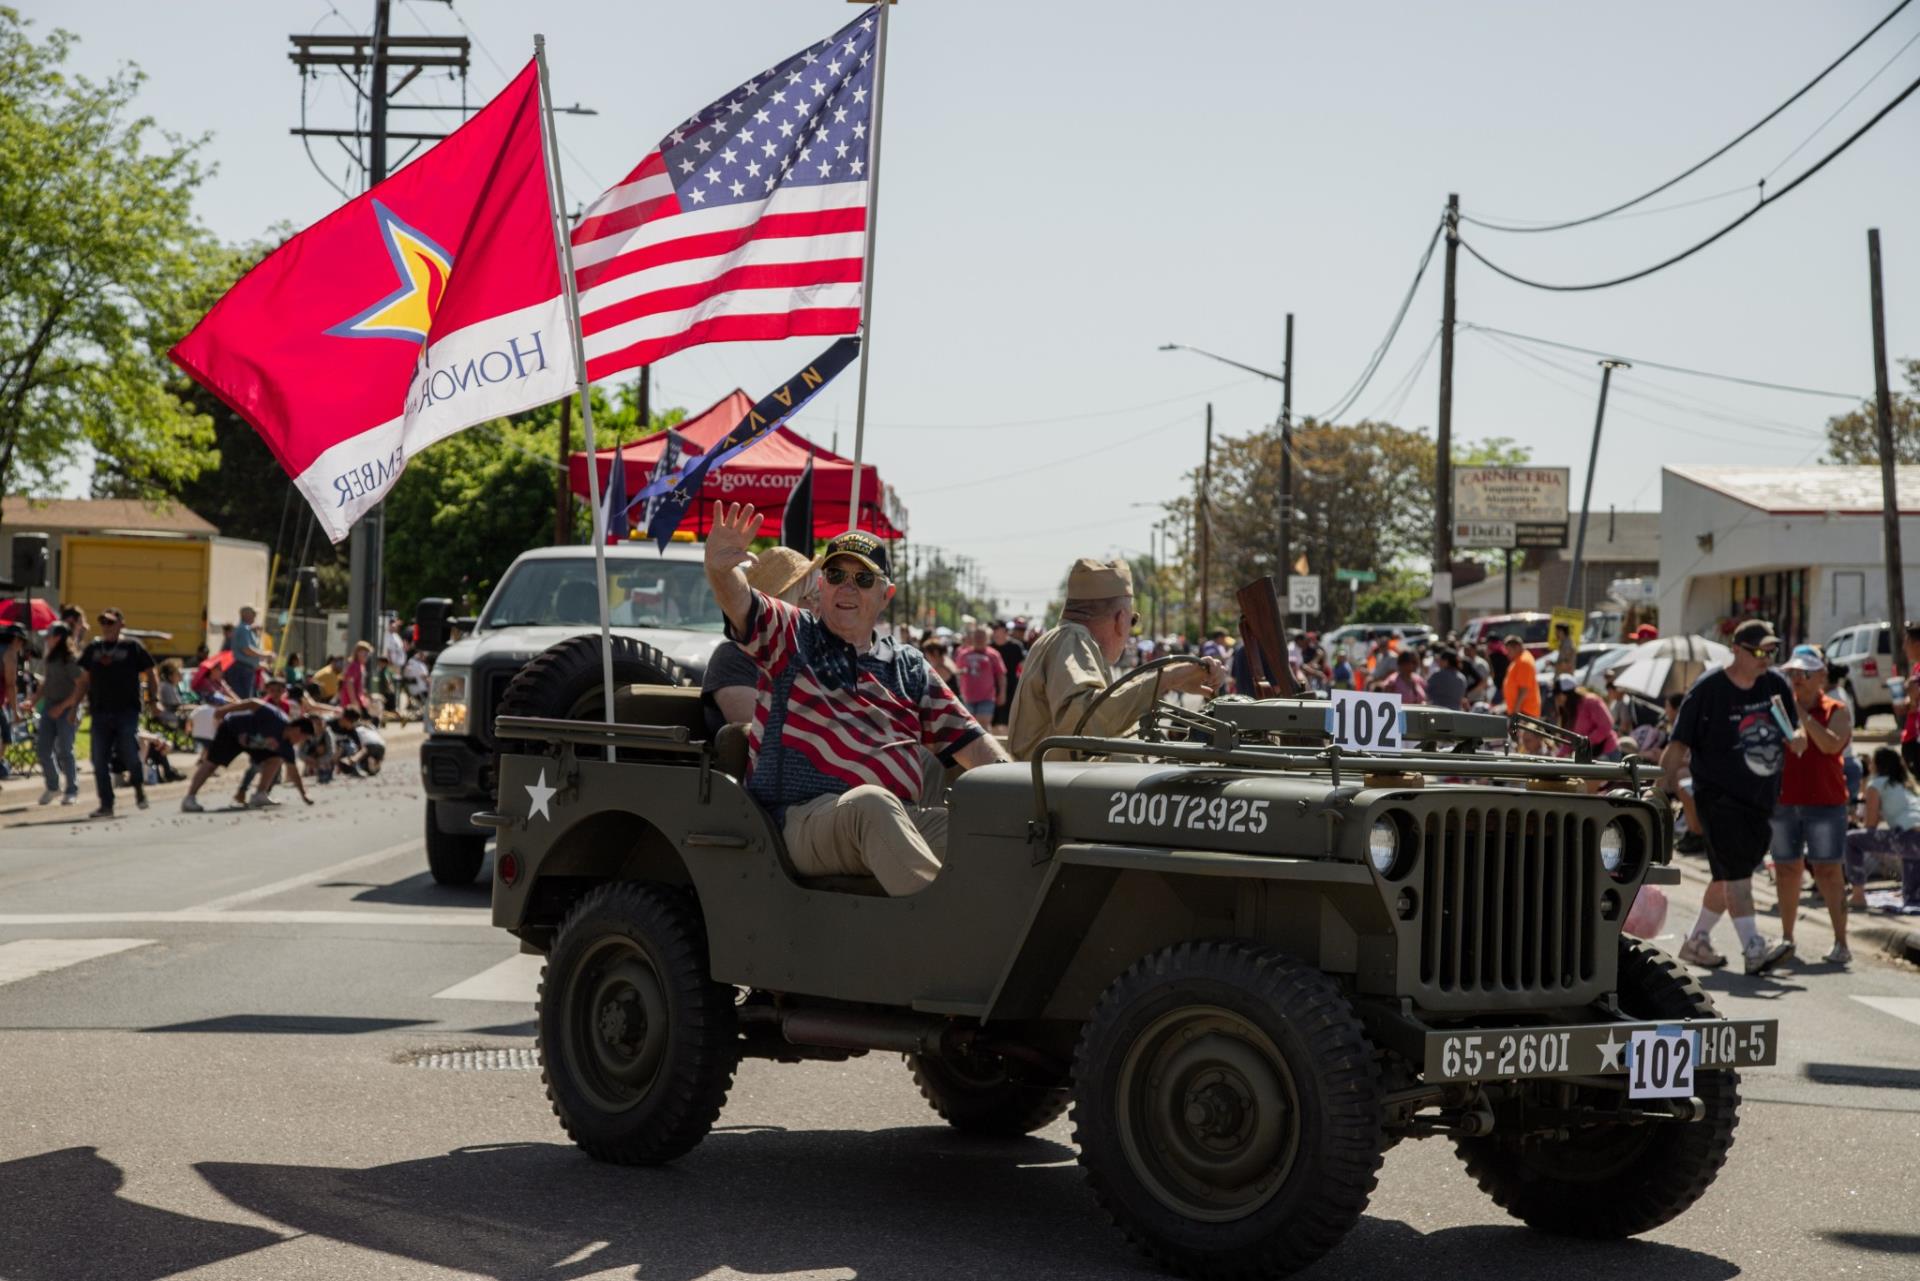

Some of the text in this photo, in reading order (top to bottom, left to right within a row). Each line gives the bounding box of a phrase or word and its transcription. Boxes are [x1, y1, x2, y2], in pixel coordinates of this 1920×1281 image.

[1460, 470, 1561, 486] CARNICERIA
[1295, 594, 1316, 608] 30
[1334, 698, 1396, 747] 102
[1108, 791, 1270, 834] 20072925
[1634, 1038, 1690, 1089] 102
[1701, 1025, 1766, 1064] HQ-5
